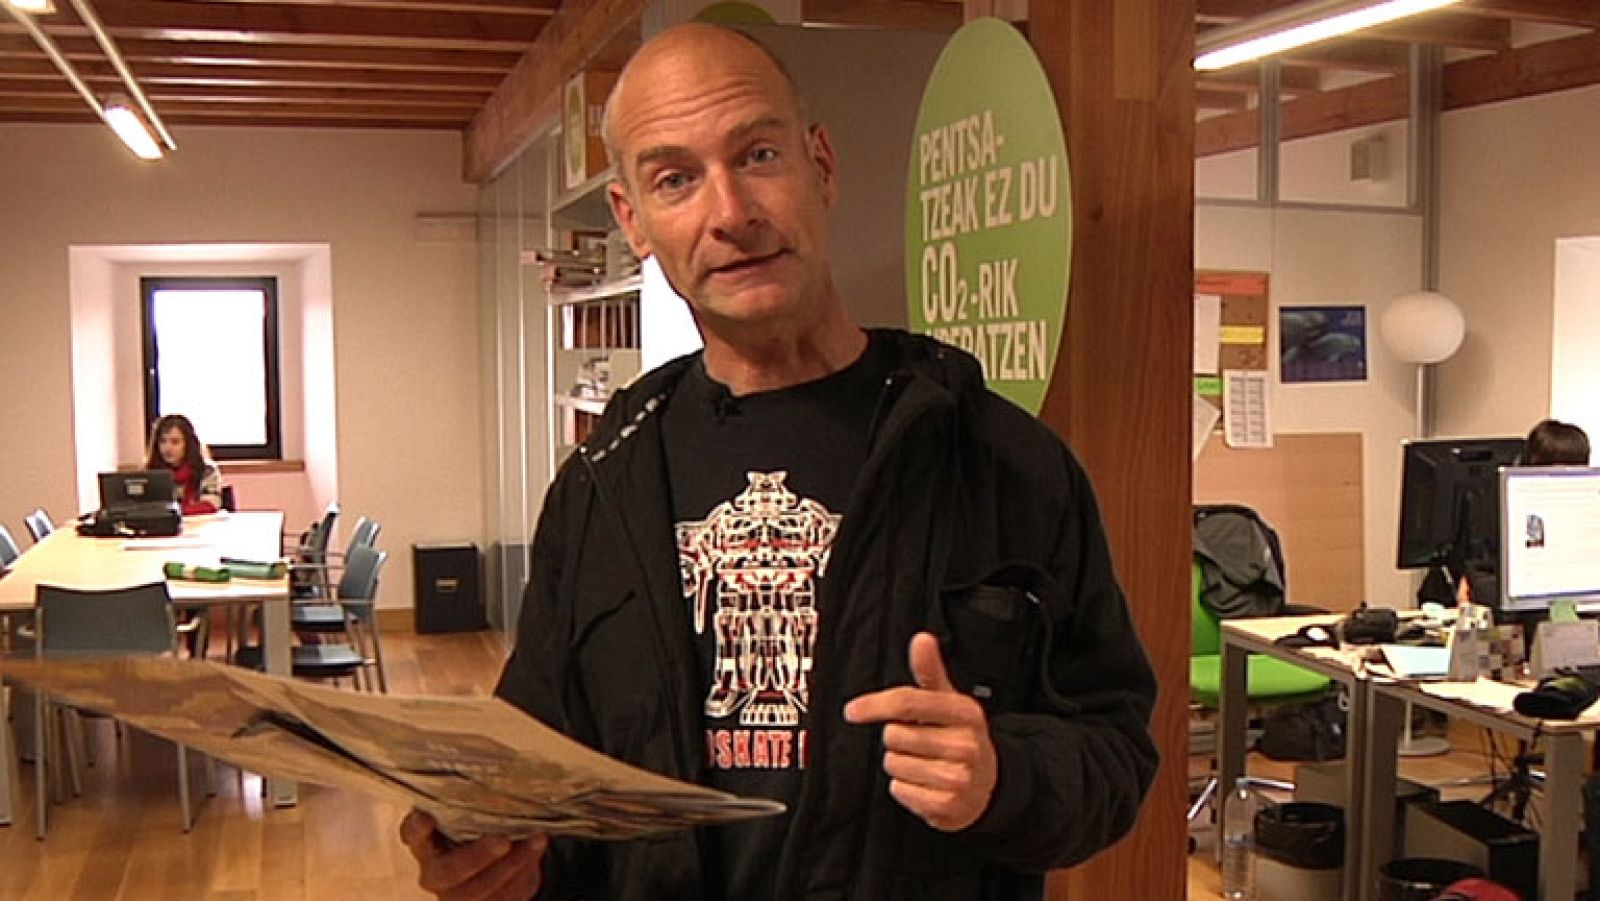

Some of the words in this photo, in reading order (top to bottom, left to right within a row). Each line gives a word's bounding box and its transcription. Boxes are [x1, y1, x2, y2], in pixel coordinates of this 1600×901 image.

[920, 110, 1005, 186] PENTSA-
[920, 176, 979, 243] TZEAK
[985, 166, 1013, 229] EZ
[1020, 154, 1058, 221] DU
